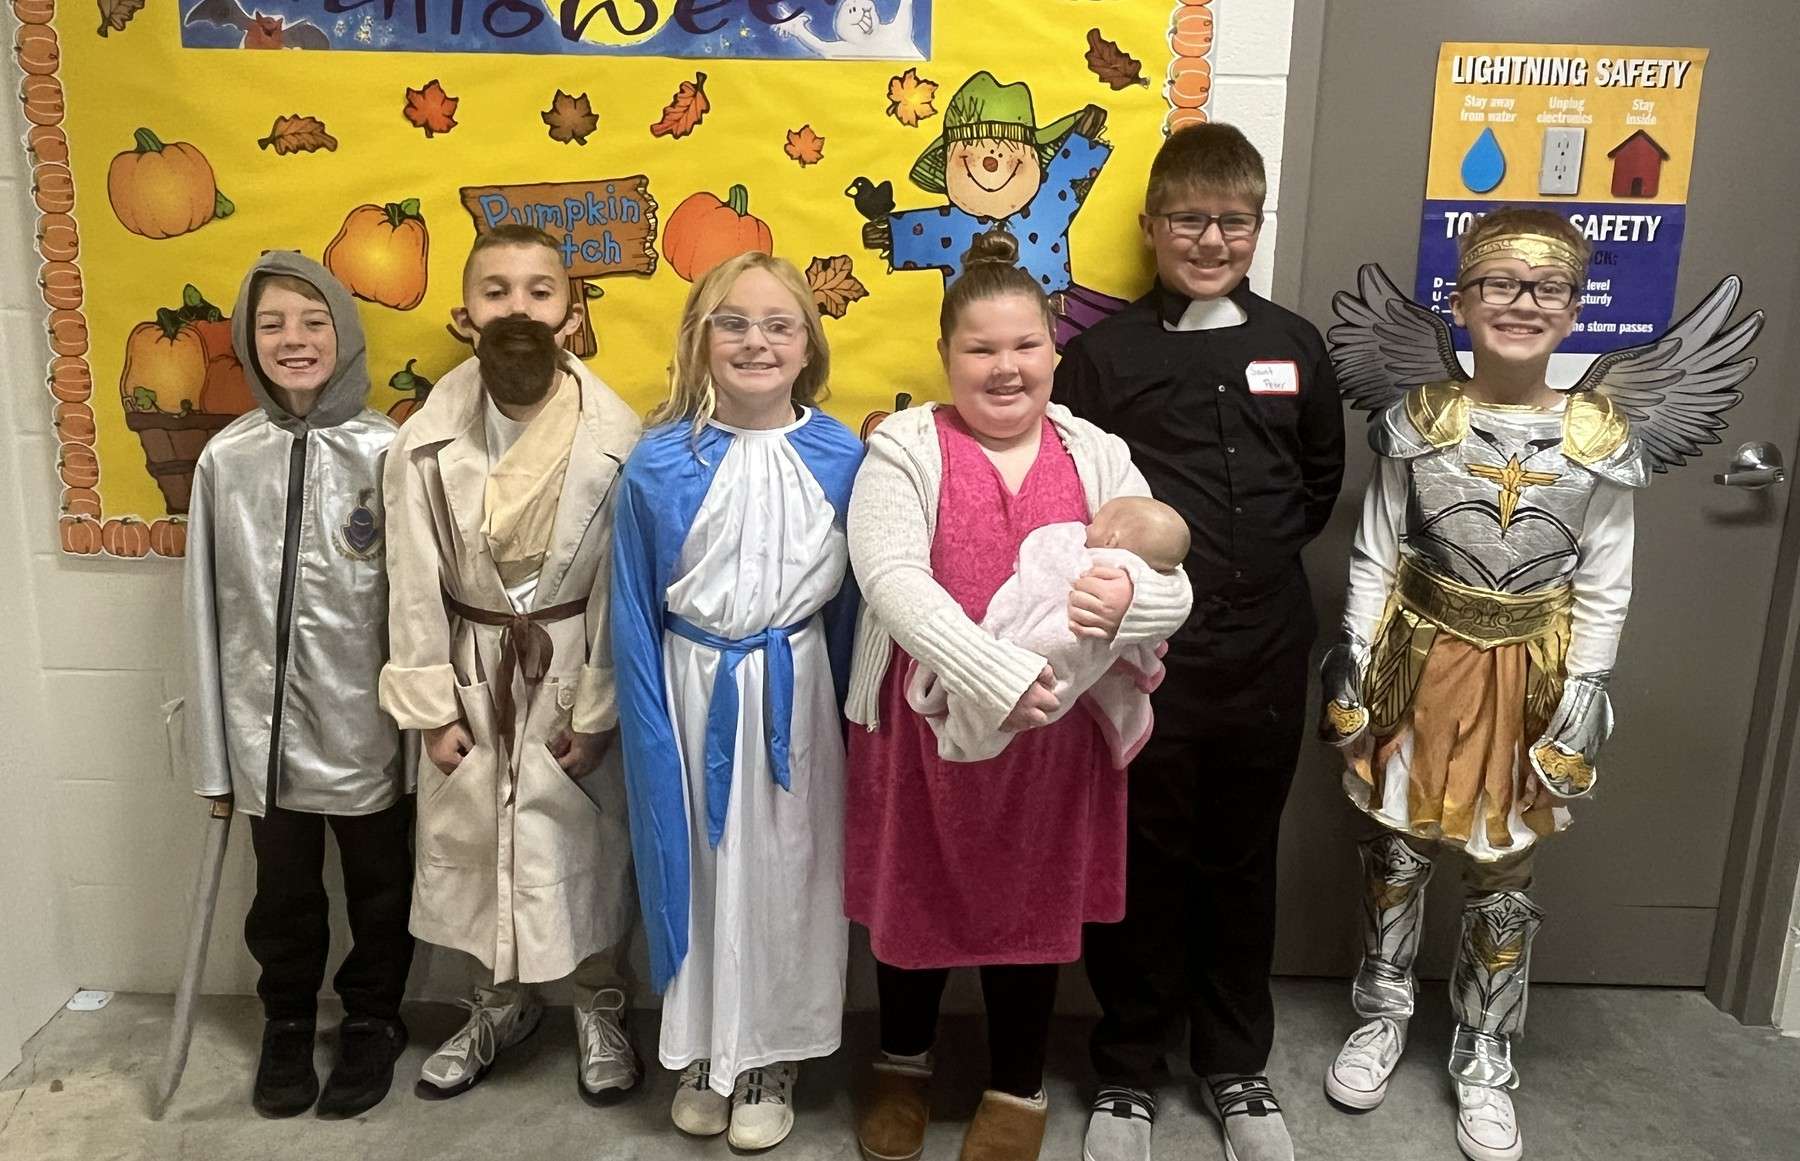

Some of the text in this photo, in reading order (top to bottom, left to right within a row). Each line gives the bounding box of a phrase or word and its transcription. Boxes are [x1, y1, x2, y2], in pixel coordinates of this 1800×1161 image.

[1451, 55, 1691, 88] LIGHTNING SAFETY
[1464, 95, 1516, 111] Stay away
[1549, 97, 1585, 112] Unplug
[1632, 99, 1655, 113] Stay
[1460, 109, 1517, 122] from water
[1536, 112, 1593, 124] electronics
[1625, 113, 1657, 125] inside
[479, 184, 641, 232] Pumpkin
[1569, 213, 1662, 241] SAFETY
[562, 230, 622, 268] tch
[1587, 279, 1611, 291] level
[1581, 293, 1613, 307] sturdy
[1587, 321, 1616, 332] storm
[1619, 323, 1654, 334] passes
